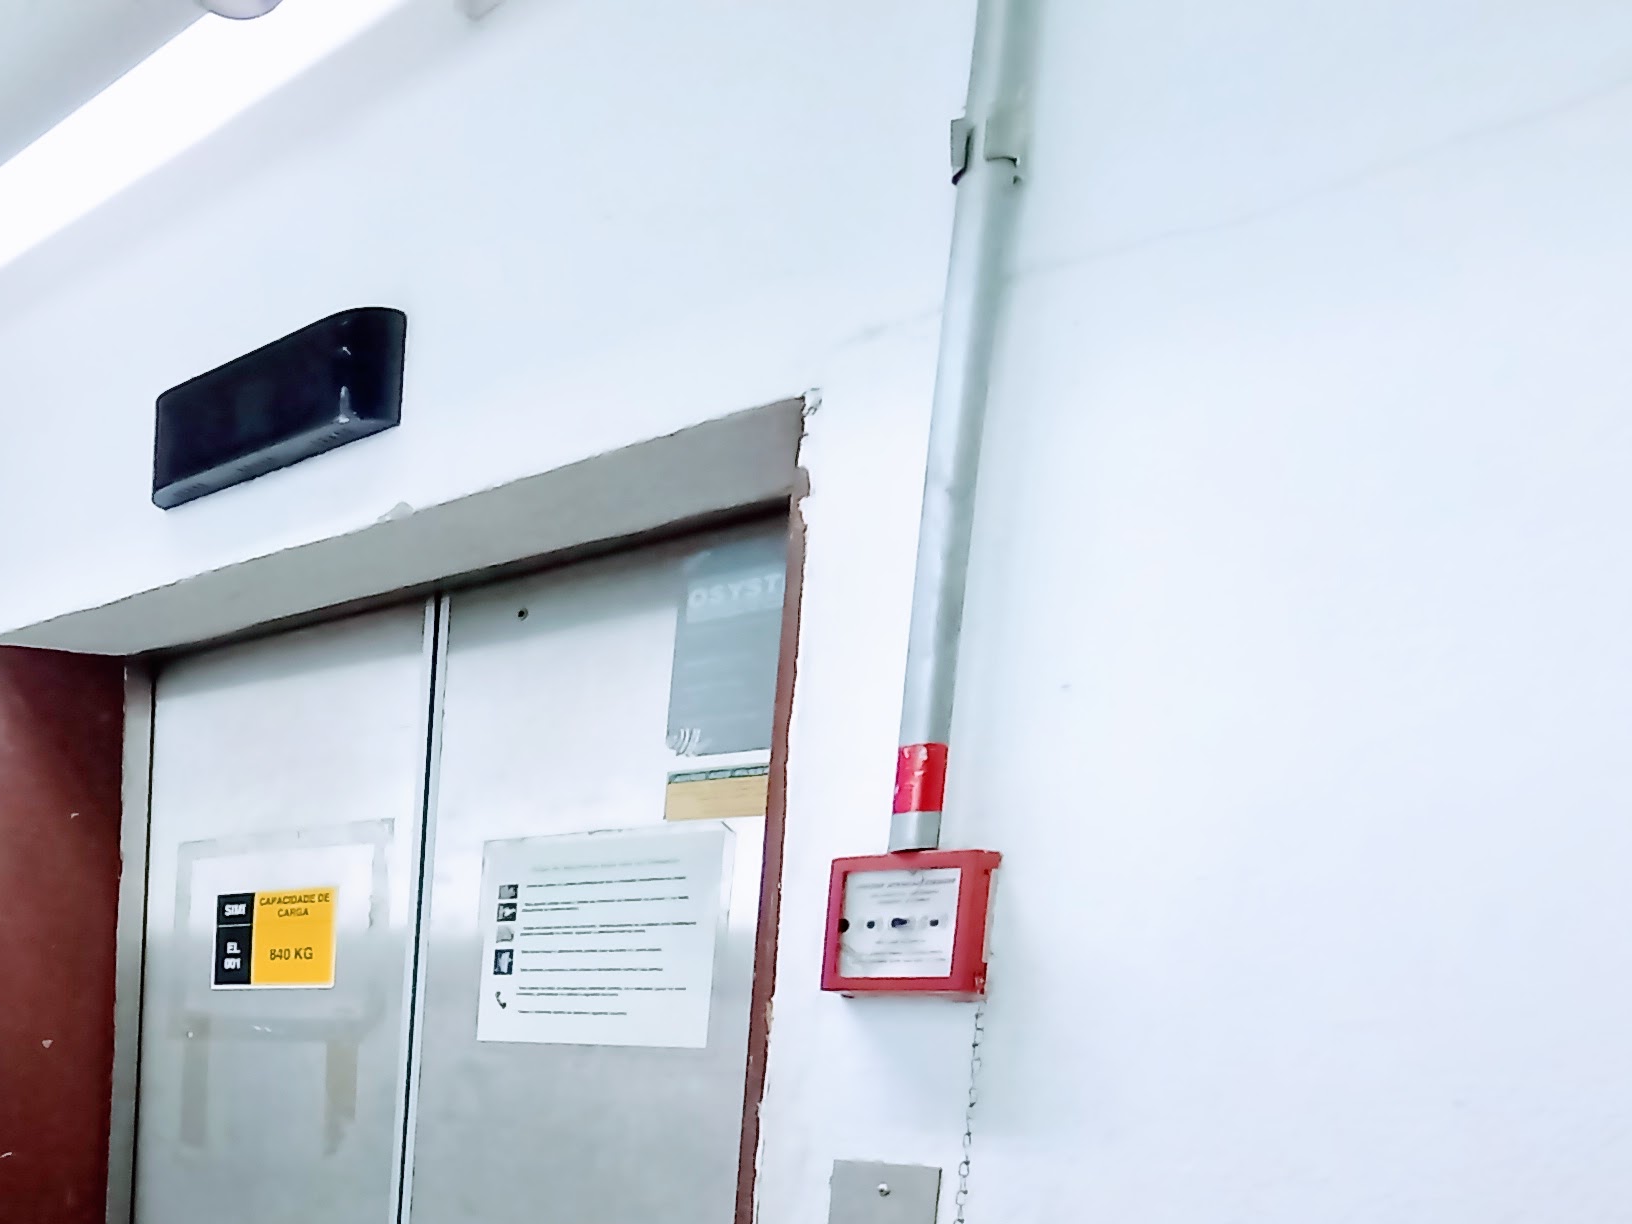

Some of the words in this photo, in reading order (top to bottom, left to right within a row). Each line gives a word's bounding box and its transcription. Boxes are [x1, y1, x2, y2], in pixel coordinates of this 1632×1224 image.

[259, 894, 315, 906] CAPACIDADE
[317, 893, 330, 903] DE
[277, 908, 309, 917] CARGA
[293, 946, 313, 960] KG
